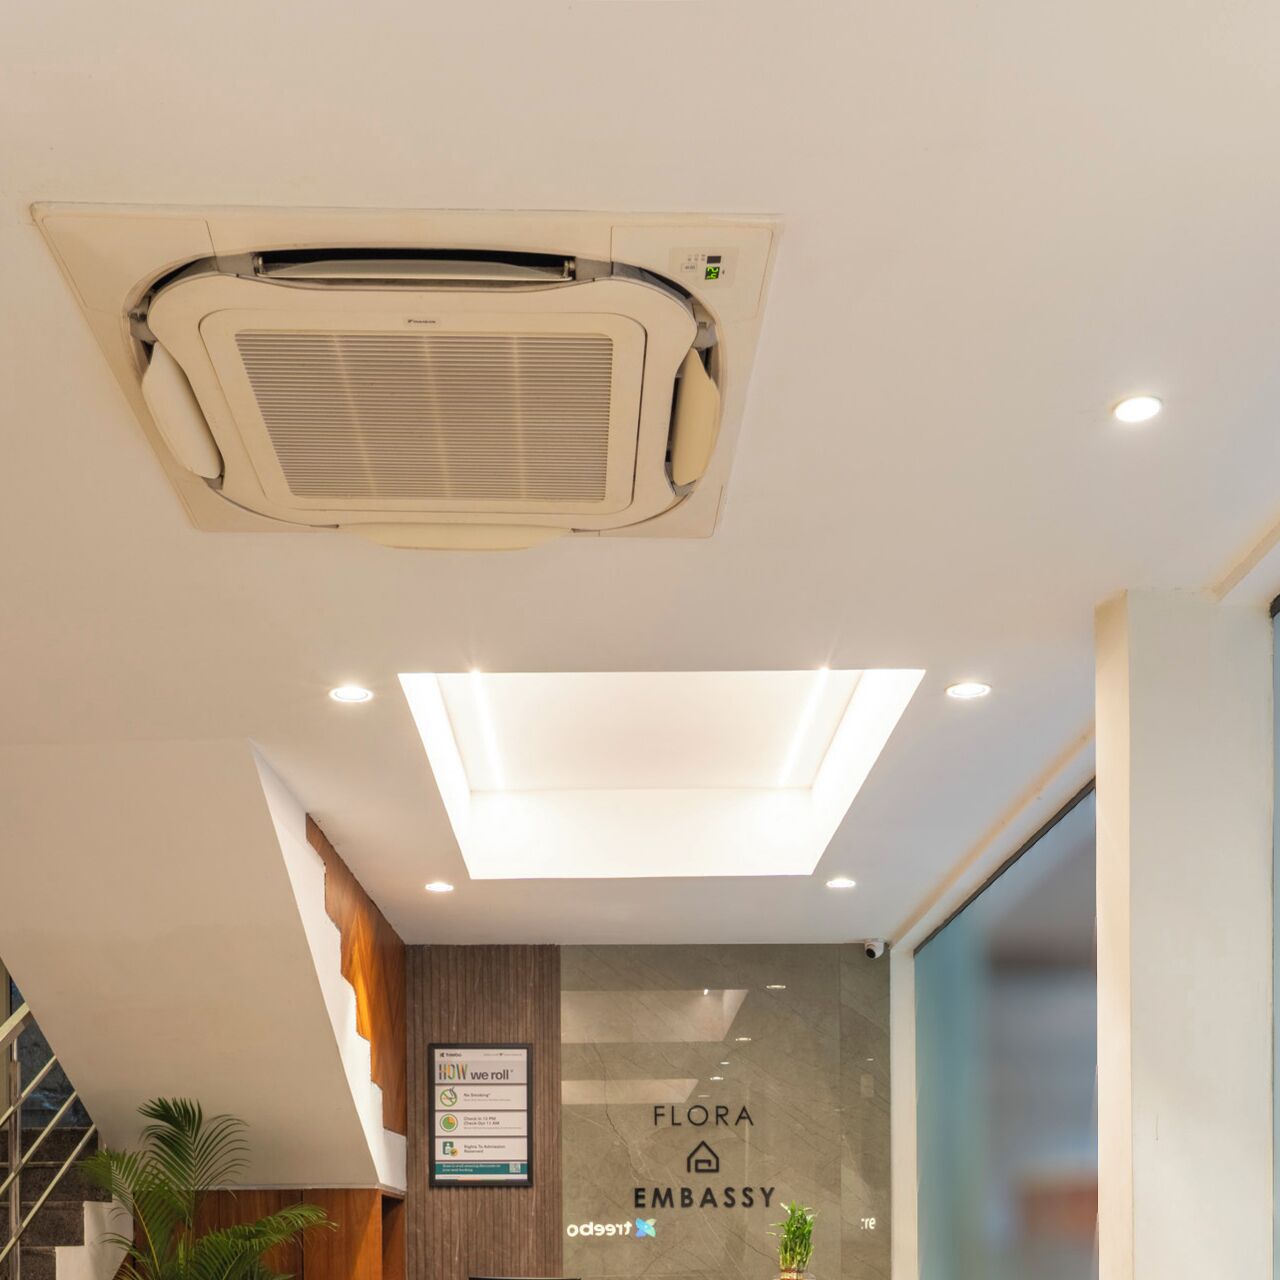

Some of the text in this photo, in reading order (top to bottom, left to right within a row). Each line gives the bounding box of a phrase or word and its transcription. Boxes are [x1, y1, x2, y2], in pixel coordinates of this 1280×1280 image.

[438, 1062, 468, 1080] HOW
[470, 1071, 489, 1080] we
[653, 1105, 754, 1126] FLORA
[634, 1187, 775, 1209] EMBASSY
